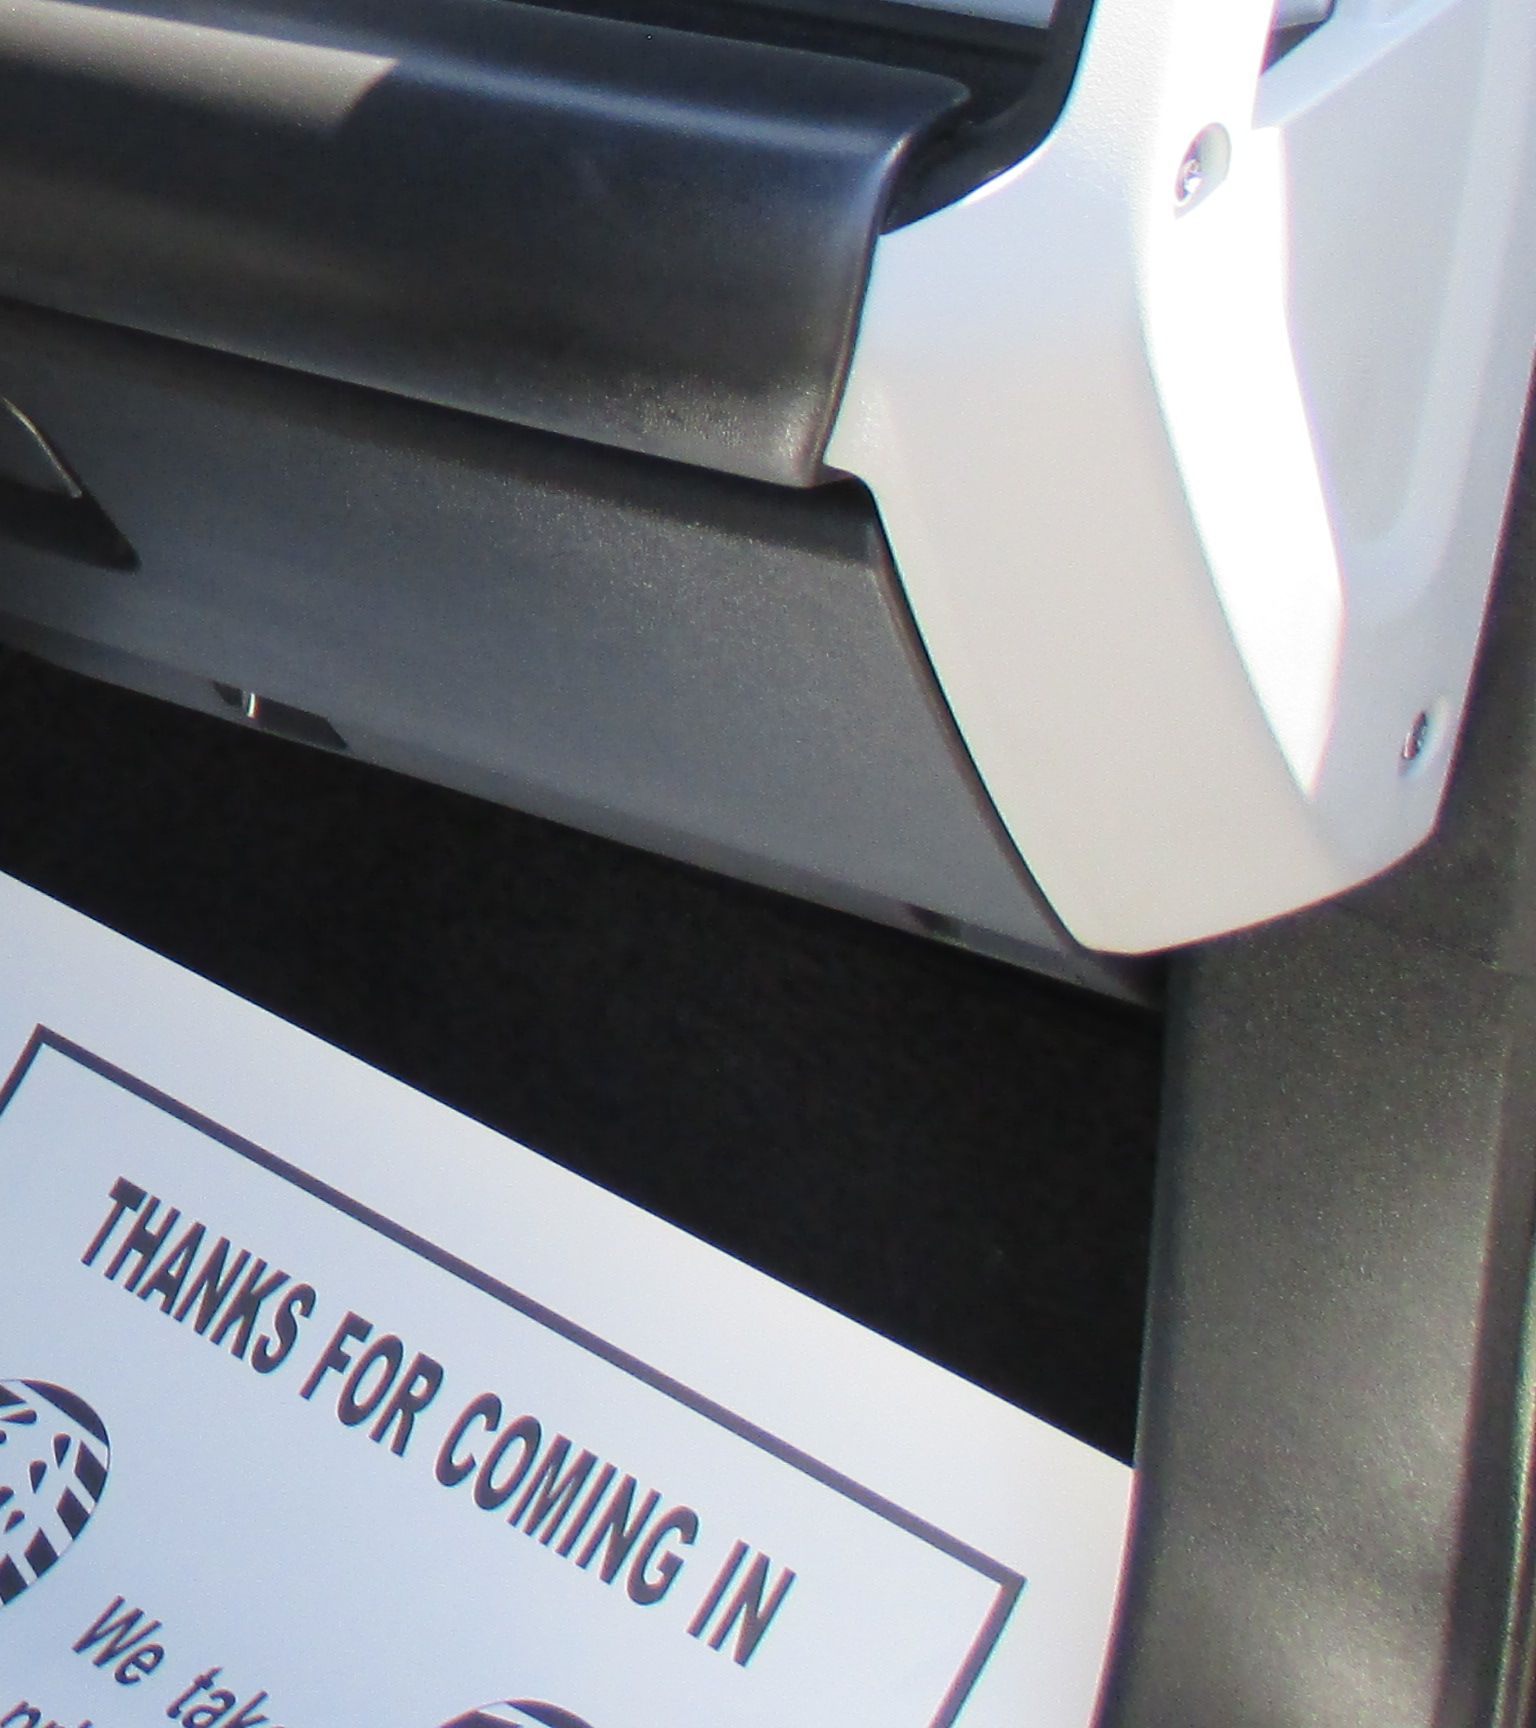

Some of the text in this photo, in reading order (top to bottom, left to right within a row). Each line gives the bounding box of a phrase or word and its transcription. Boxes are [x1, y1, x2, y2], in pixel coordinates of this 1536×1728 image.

[81, 1176, 796, 1667] THANKS FOR COMING IN
[71, 1595, 285, 1728] We tak
